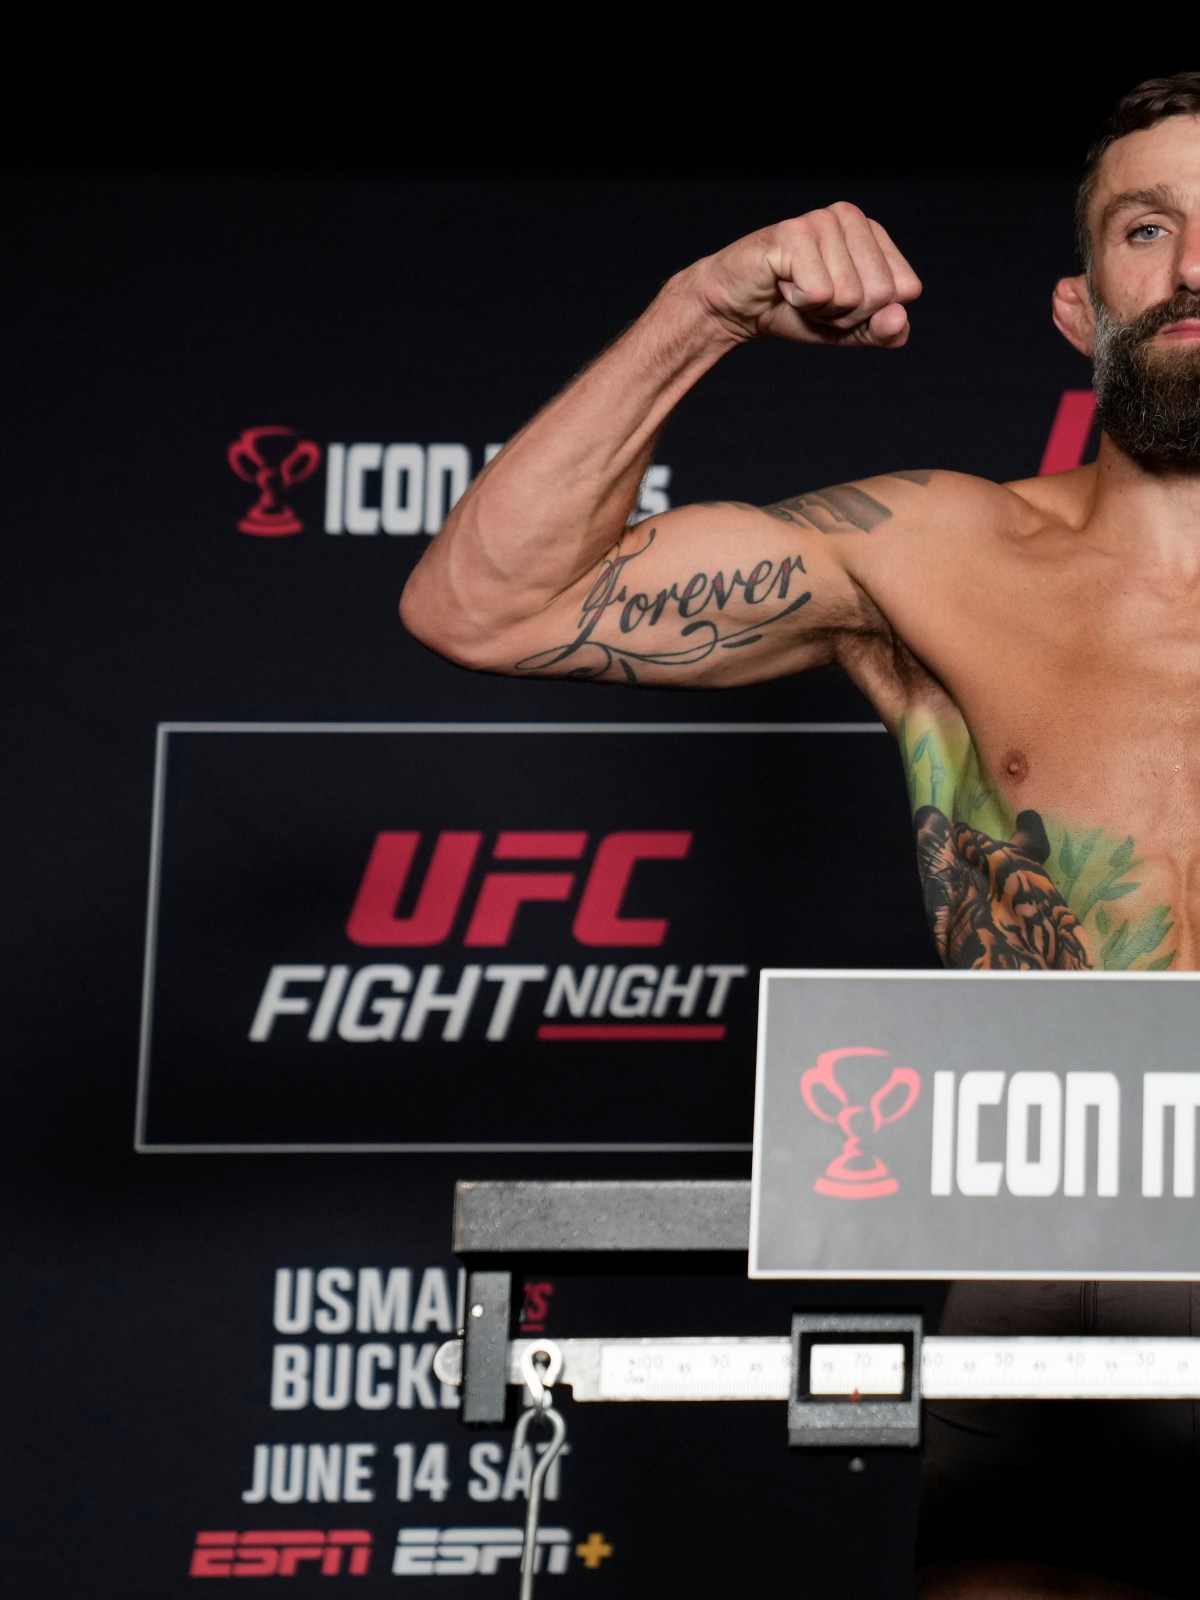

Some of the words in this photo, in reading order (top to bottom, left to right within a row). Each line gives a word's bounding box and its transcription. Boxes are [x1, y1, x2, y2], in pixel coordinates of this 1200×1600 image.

[325, 443, 470, 536] ICON
[575, 530, 807, 645] Forever
[346, 831, 692, 947] UFC
[248, 964, 546, 1042] FIGHT
[543, 964, 747, 1019] NIGHT
[931, 1070, 1120, 1197] ICON
[272, 1266, 467, 1334] USMA
[242, 1442, 376, 1503] JUNE
[393, 1442, 450, 1502] 14
[467, 1442, 569, 1502] SAT
[190, 1529, 373, 1577] ESPN
